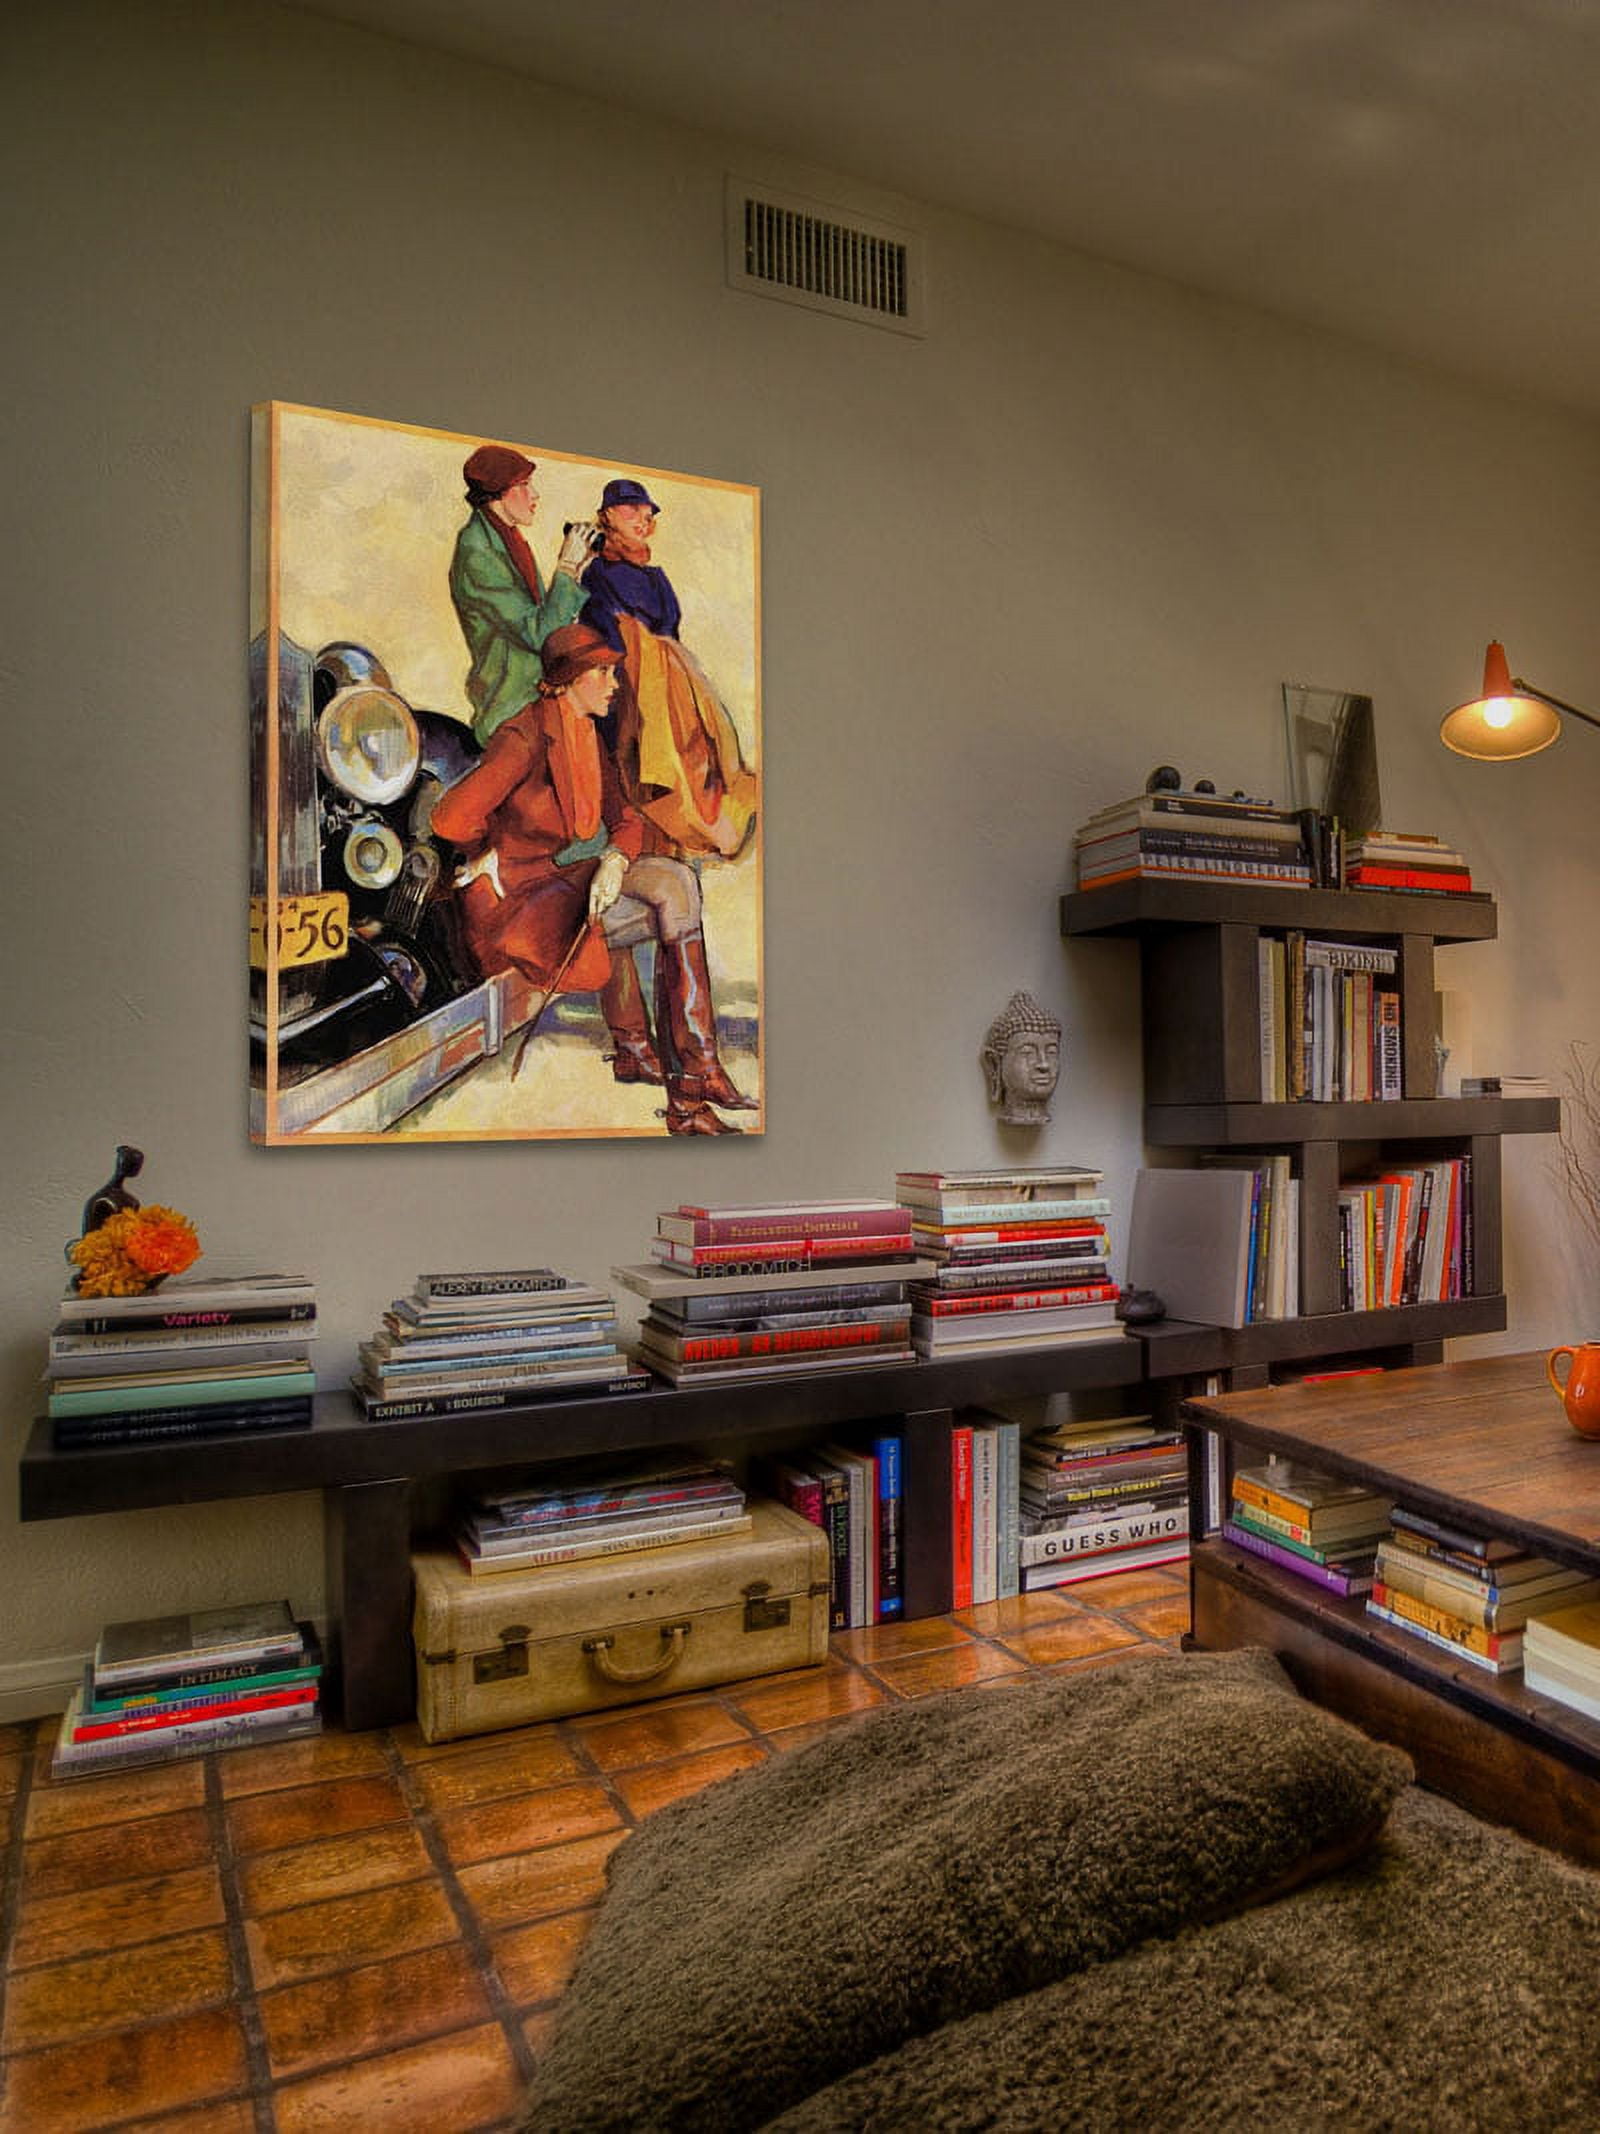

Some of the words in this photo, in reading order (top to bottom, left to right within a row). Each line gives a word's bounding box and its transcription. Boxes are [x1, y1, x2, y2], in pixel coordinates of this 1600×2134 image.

[1328, 949, 1383, 971] BIKINI
[1383, 1026, 1400, 1090] SMOKING
[163, 1311, 233, 1328] Variety
[1044, 1528, 1121, 1556] GUESS
[1128, 1518, 1179, 1540] WHO
